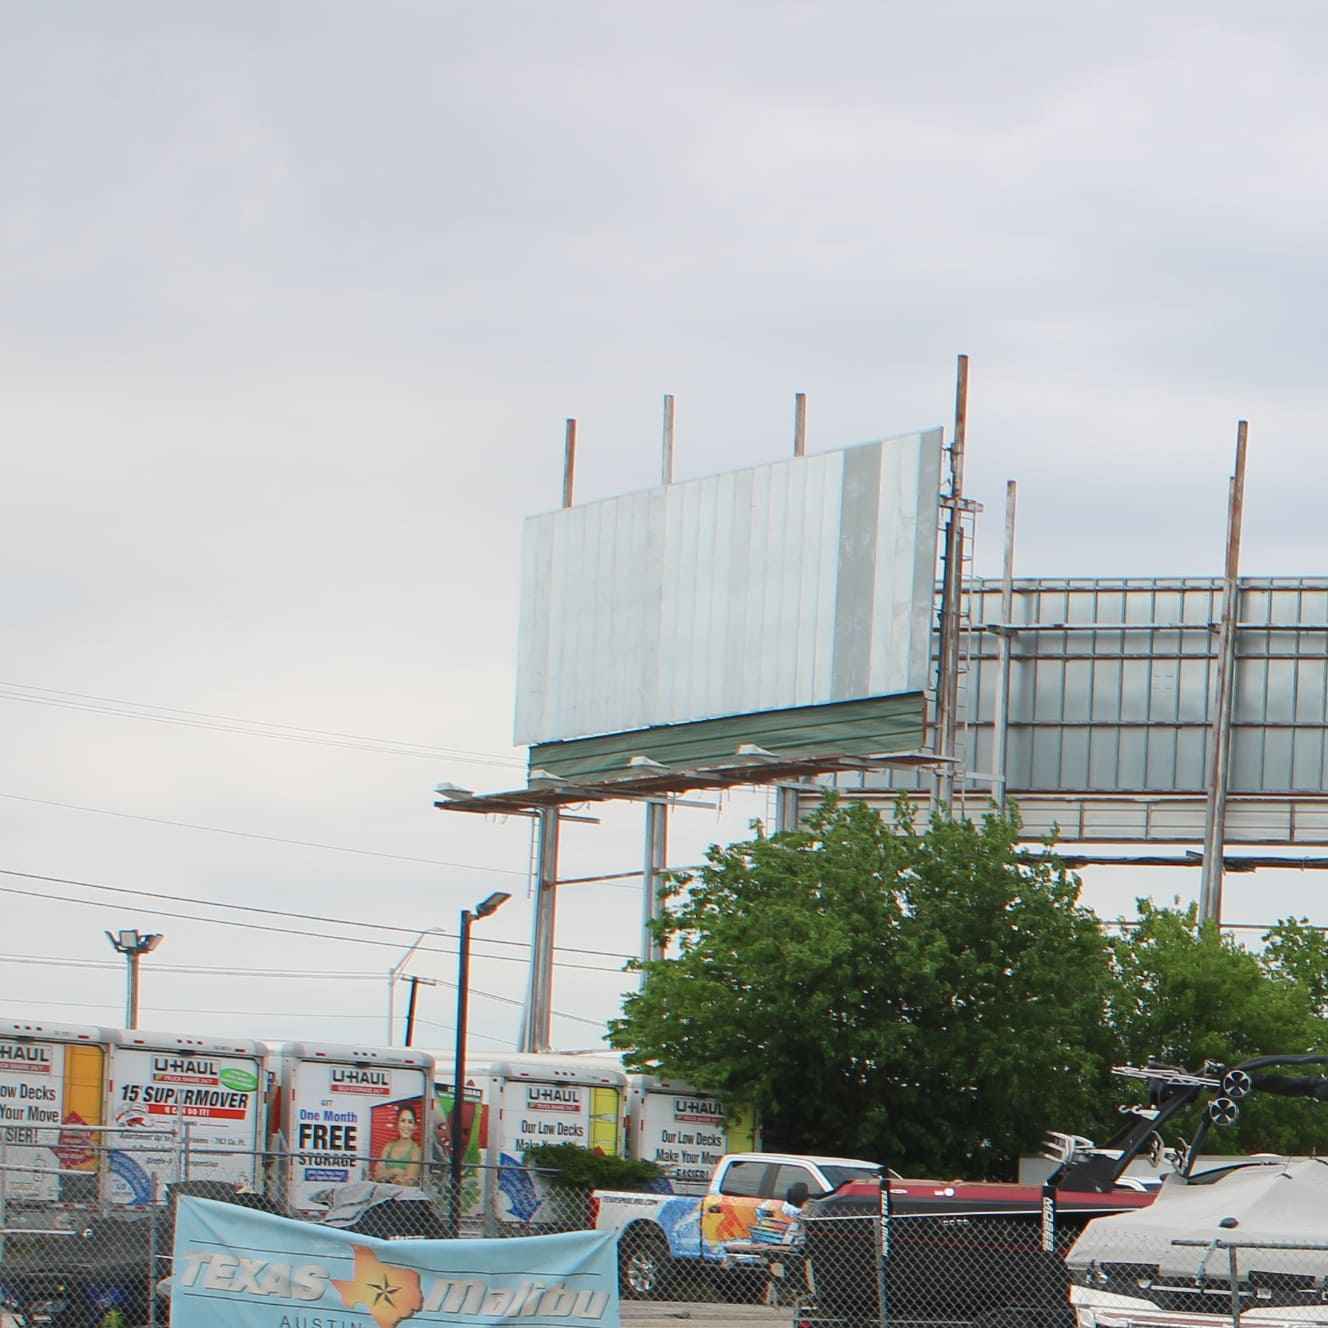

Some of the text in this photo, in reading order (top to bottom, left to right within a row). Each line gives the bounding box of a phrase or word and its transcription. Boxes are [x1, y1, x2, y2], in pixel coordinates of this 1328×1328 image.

[155, 1058, 218, 1076] U-HAUL
[332, 1070, 389, 1086] U-HAUL
[20, 1083, 56, 1101] Decks
[529, 1088, 580, 1103] U-HAUL
[27, 1106, 60, 1122] Move
[300, 1109, 358, 1122] One Month
[521, 1120, 536, 1133] Our
[557, 1122, 584, 1136] Decks
[299, 1124, 357, 1151] FREE
[696, 1132, 722, 1146] Decks
[299, 1152, 357, 1168] STORAGE
[656, 1149, 680, 1162] Make
[180, 1252, 611, 1320] TEXAS Malibu
